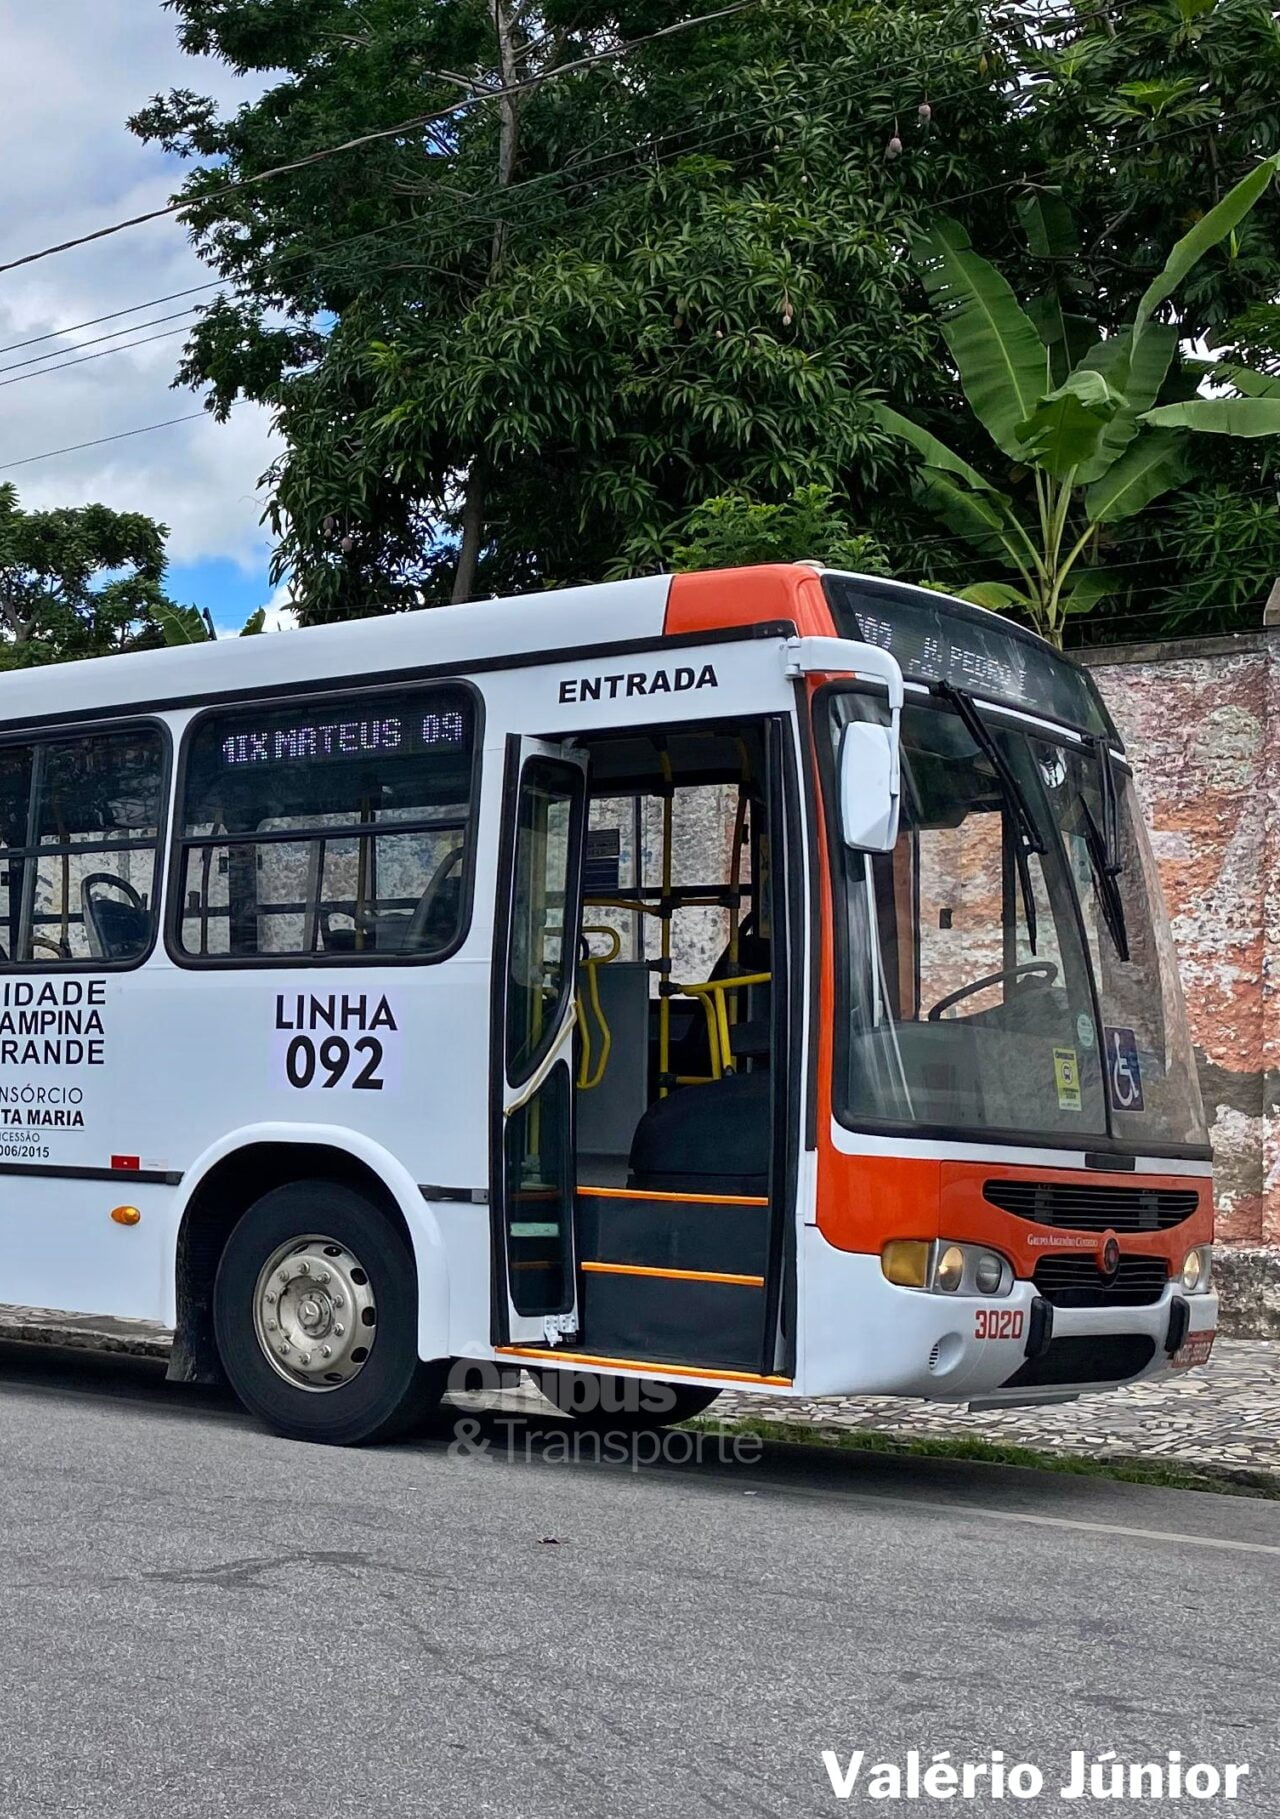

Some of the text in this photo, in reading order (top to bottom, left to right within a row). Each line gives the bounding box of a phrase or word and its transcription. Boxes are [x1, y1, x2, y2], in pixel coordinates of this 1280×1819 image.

[558, 664, 719, 704] ENTRADA
[274, 718, 402, 759] MATEUS
[275, 994, 398, 1031] LINHA
[286, 1034, 384, 1090] 092
[27, 1109, 85, 1127] MARIA
[975, 1310, 1024, 1339] 3020
